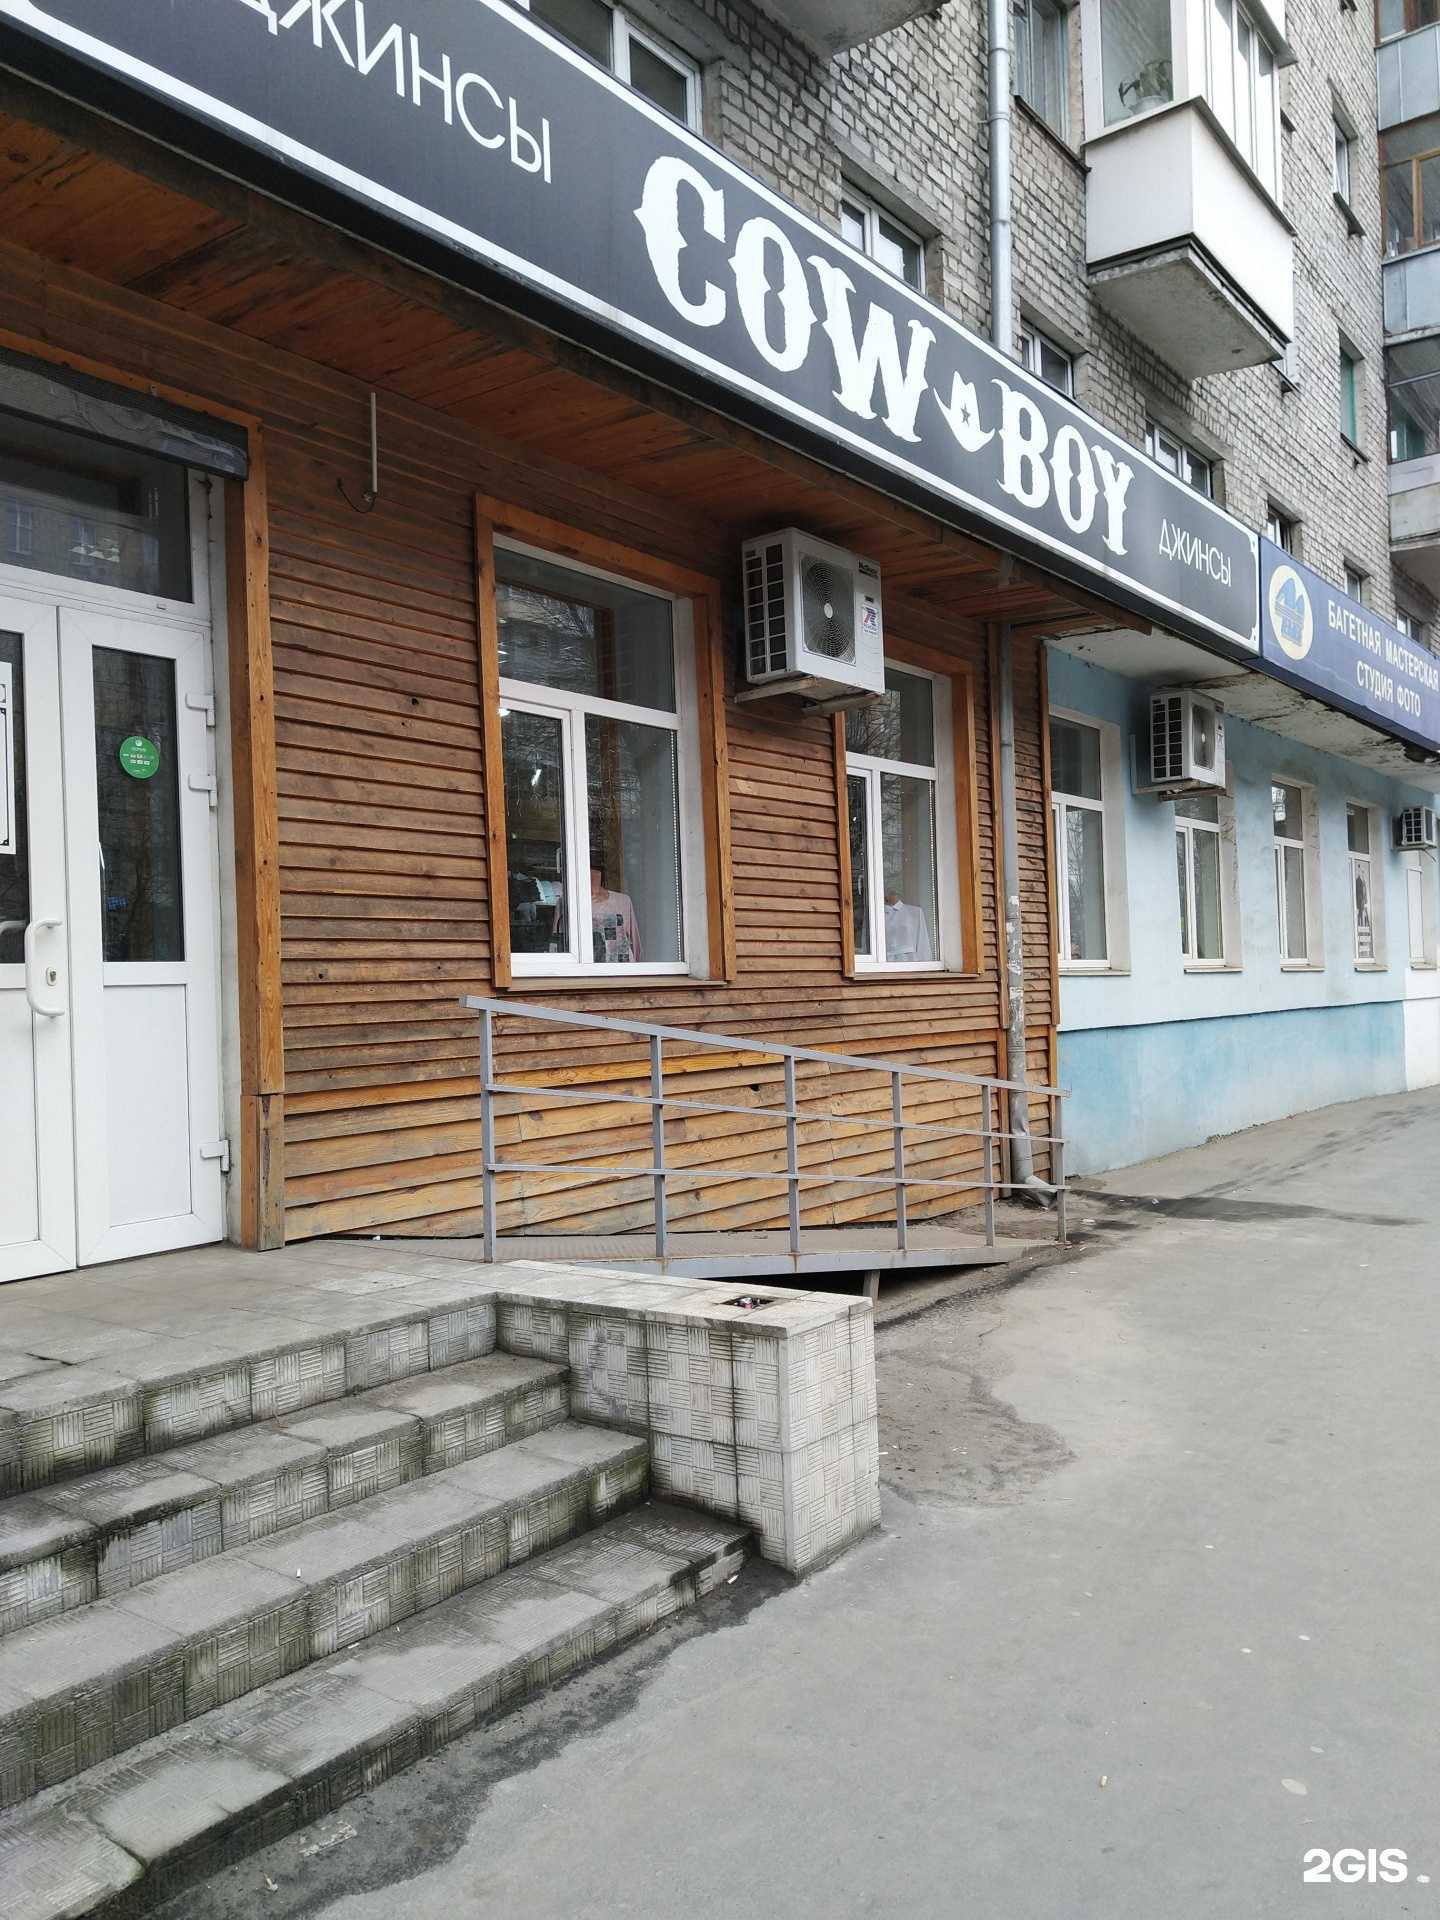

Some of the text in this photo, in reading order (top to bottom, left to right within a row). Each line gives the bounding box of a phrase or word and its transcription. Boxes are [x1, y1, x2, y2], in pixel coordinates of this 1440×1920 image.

[239, 0, 552, 184] ЖИНСЫ
[633, 155, 1135, 557] COW BOY
[1159, 518, 1232, 588] ДЖИНСЫ
[1328, 599, 1439, 692] БАГЕТНАЯ МАСТЕРСКАЯ
[1356, 660, 1421, 718] СТУДИЯ ФОТО
